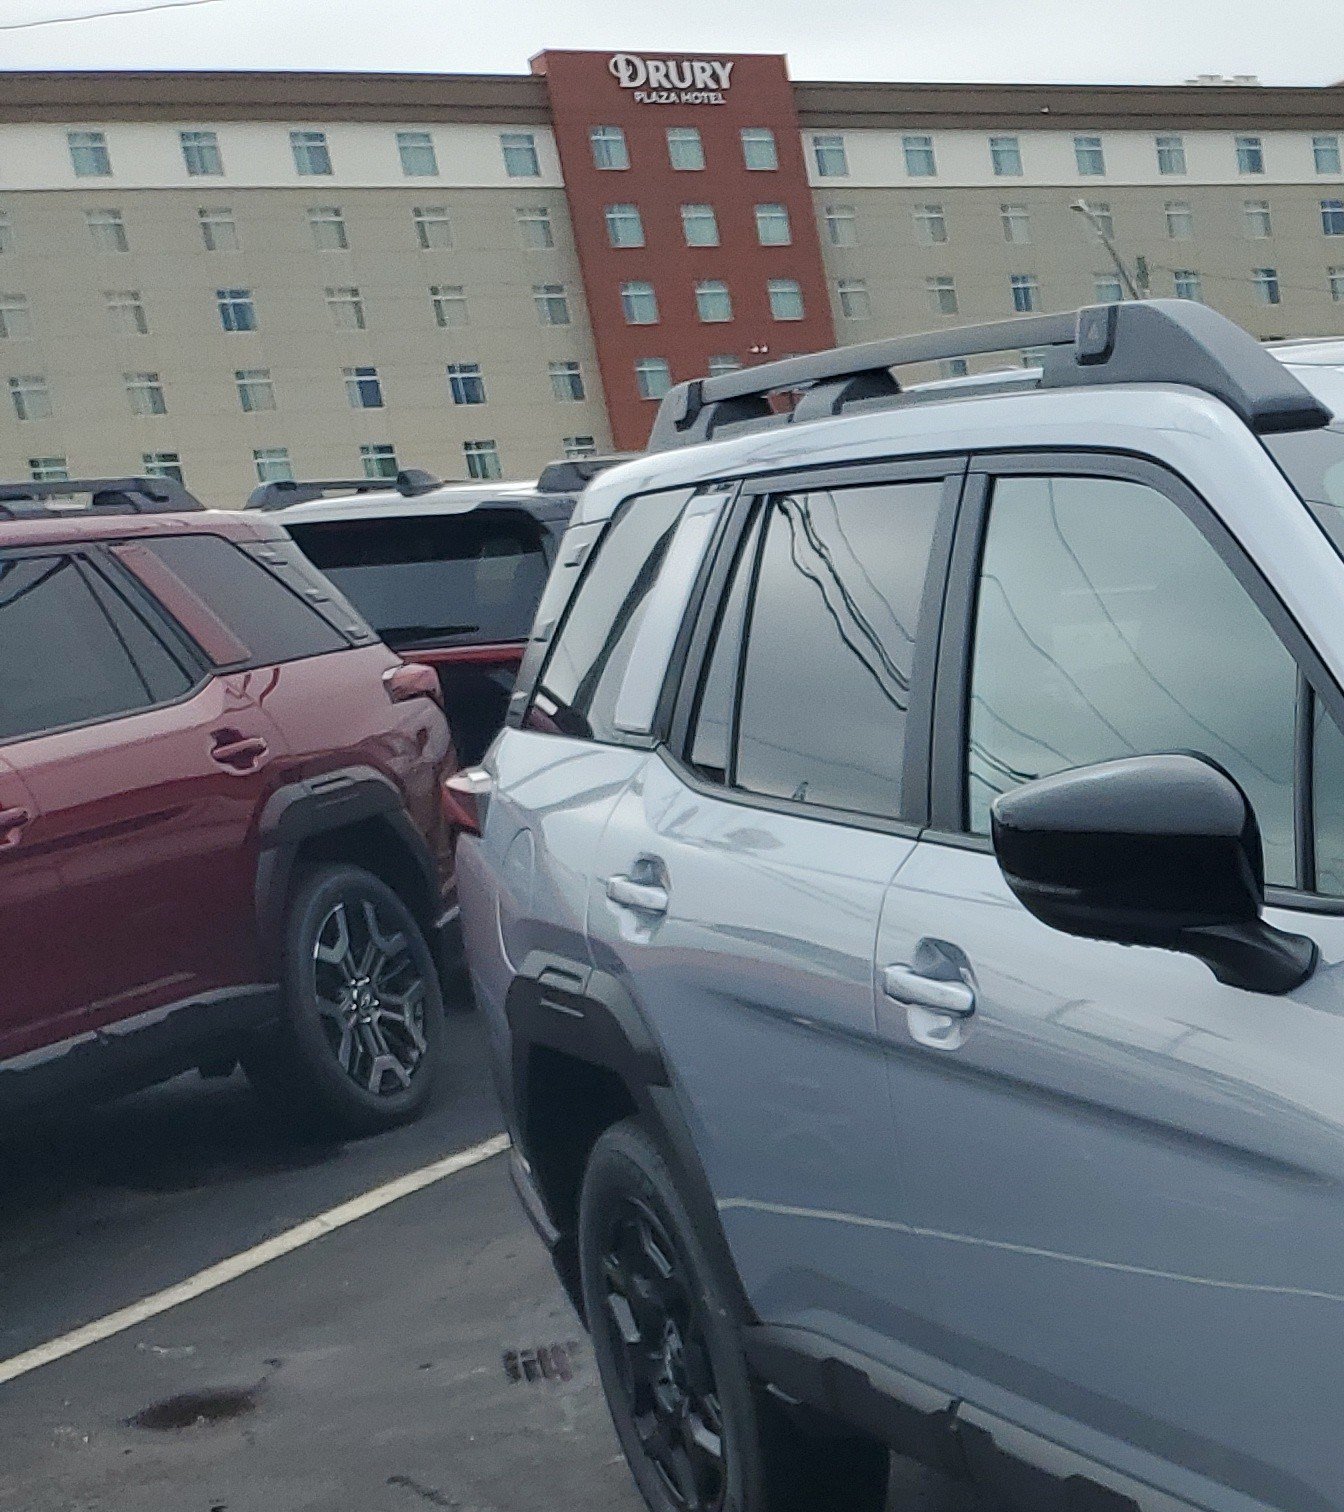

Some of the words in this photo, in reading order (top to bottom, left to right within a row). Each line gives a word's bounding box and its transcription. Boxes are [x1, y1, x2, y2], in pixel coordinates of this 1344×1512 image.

[608, 54, 734, 89] DRURY
[634, 91, 680, 104] PLAZA
[681, 91, 727, 105] HOTEL
